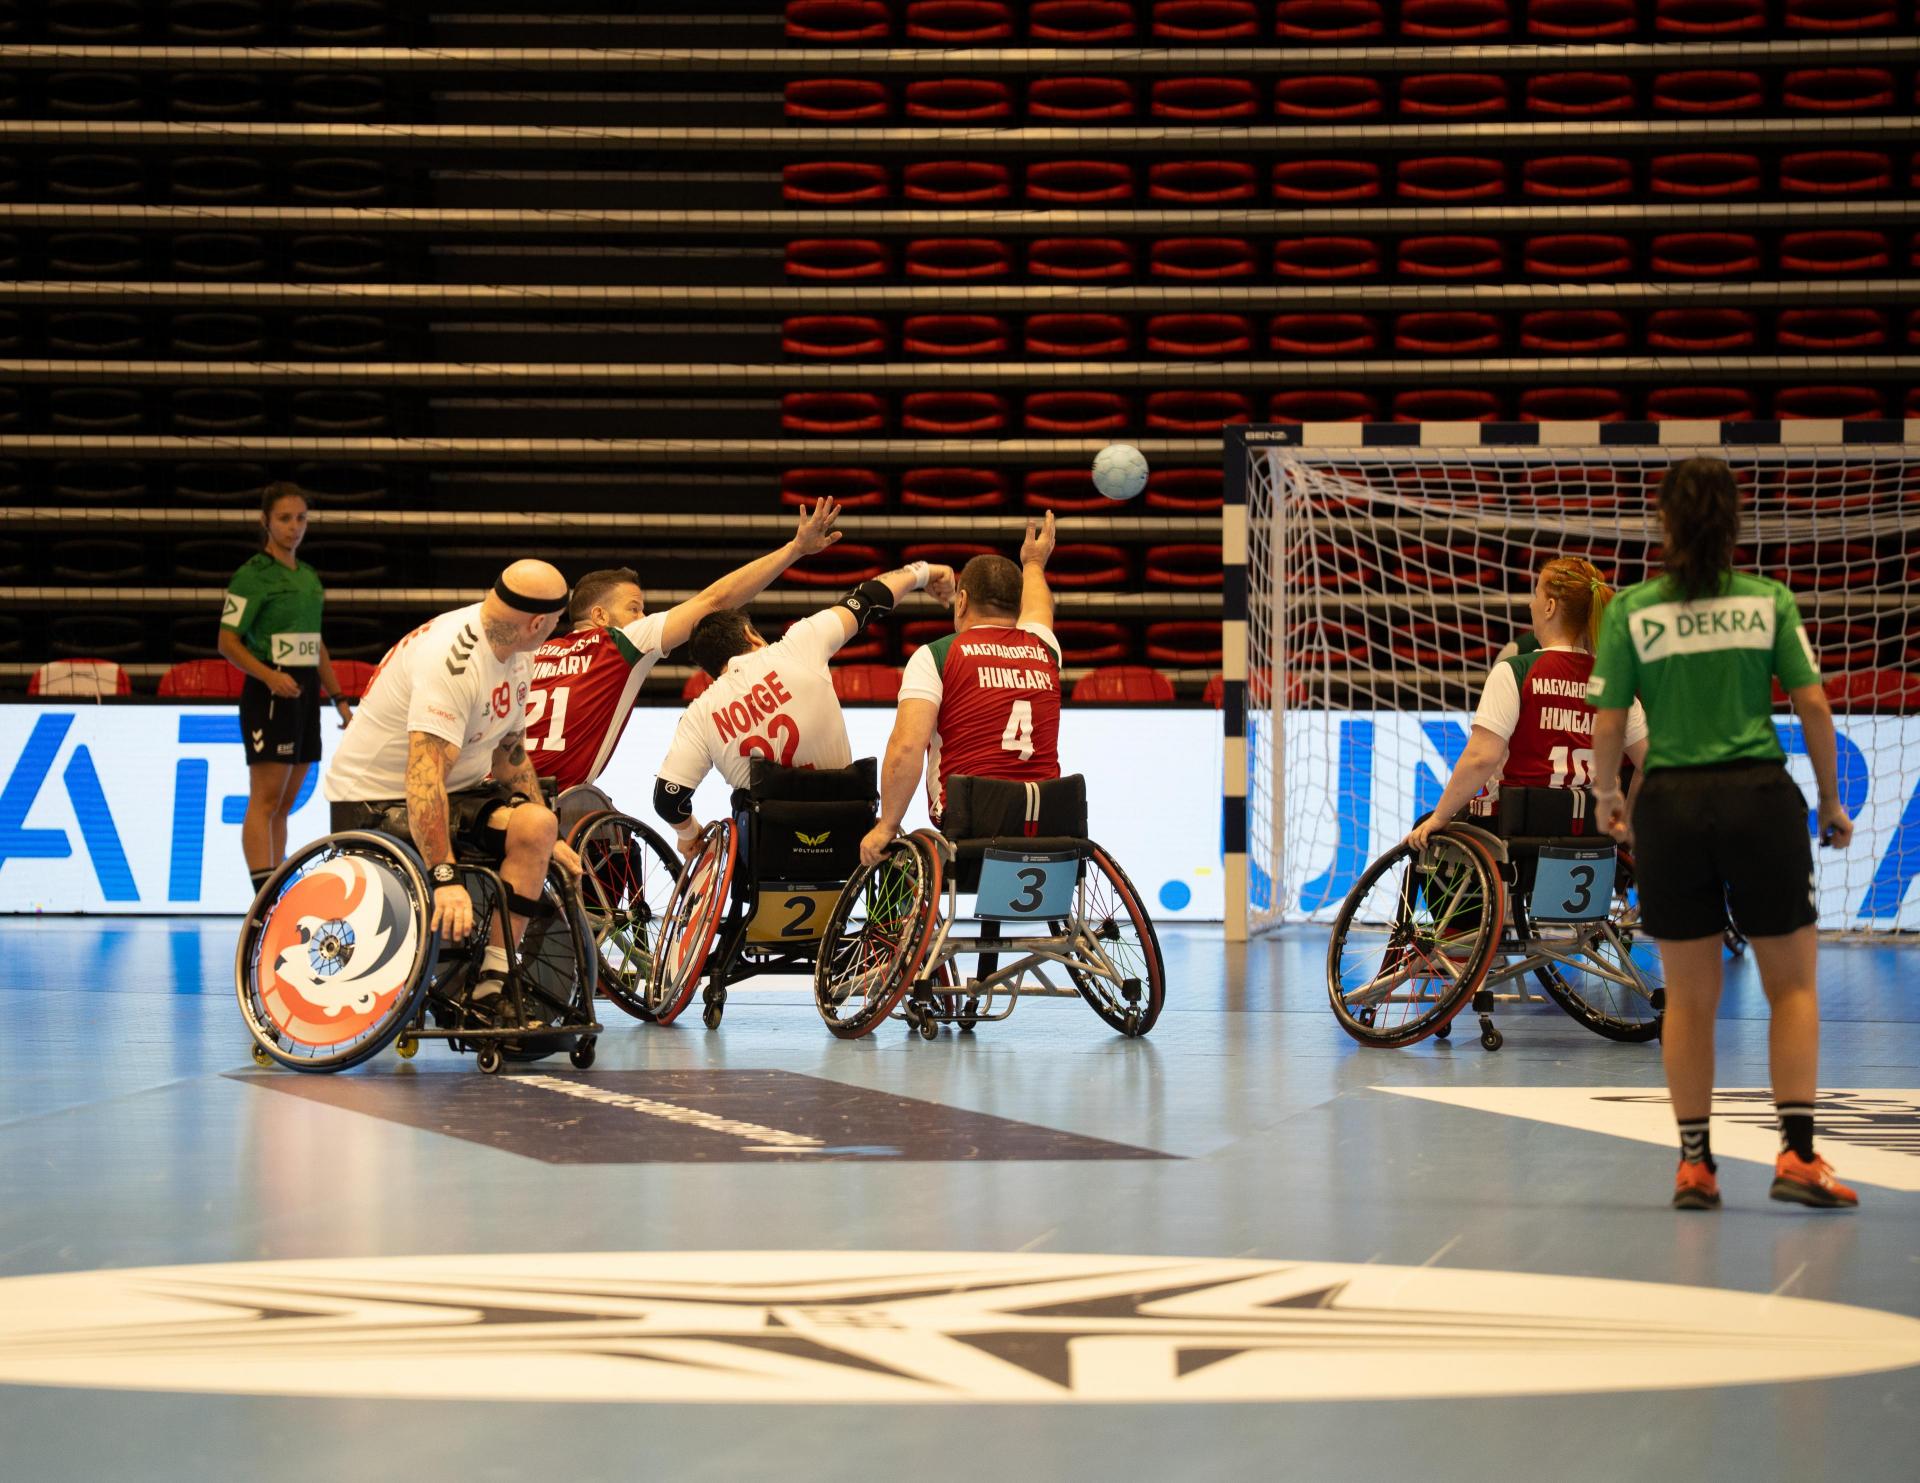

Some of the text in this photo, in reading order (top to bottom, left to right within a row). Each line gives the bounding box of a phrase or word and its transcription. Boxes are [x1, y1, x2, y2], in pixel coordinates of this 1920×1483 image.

[1676, 610, 1766, 637] DEKRA
[299, 641, 320, 655] DE
[960, 643, 1049, 663] MAGYARORSZÁG
[977, 666, 1054, 691] HUNGARY
[1531, 678, 1588, 699] MAGYARO
[525, 686, 571, 752] 21
[711, 670, 793, 745] NORGE
[1001, 699, 1035, 761] 4
[1008, 867, 1047, 913] 3
[1561, 864, 1595, 914] 3
[780, 895, 816, 937] 2
